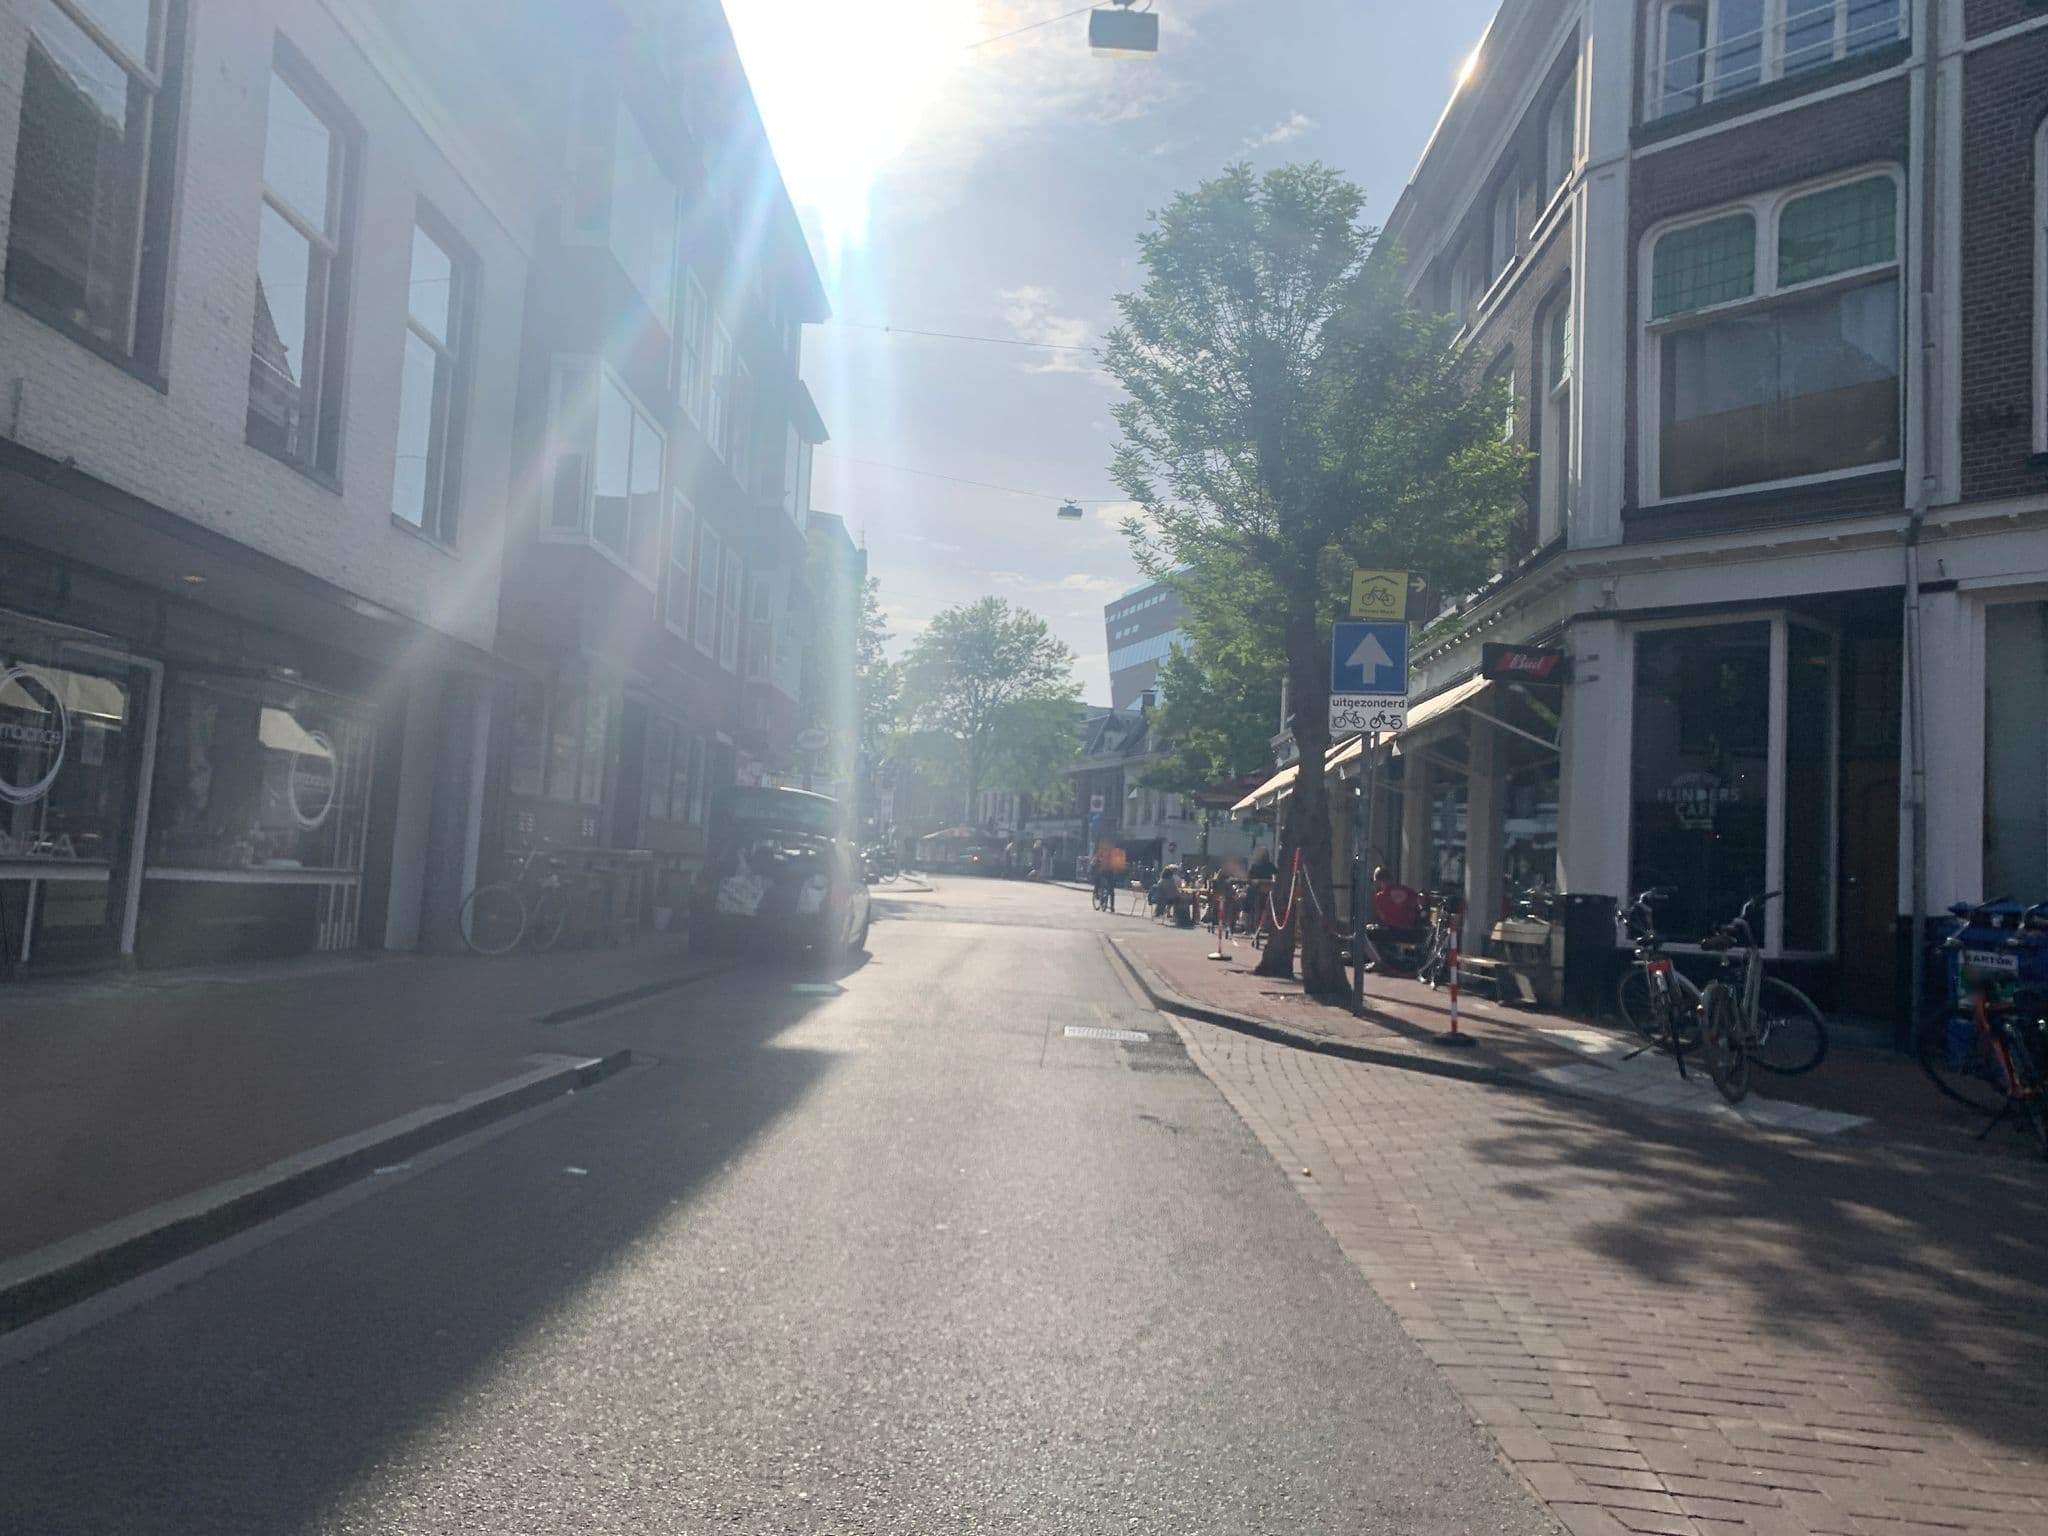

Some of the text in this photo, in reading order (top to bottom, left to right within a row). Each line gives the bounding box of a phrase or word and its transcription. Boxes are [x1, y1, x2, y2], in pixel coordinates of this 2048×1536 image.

[1509, 653, 1545, 671] Bud
[1332, 697, 1405, 710] uitgezonderd
[1656, 787, 1740, 801] FLINDERS
